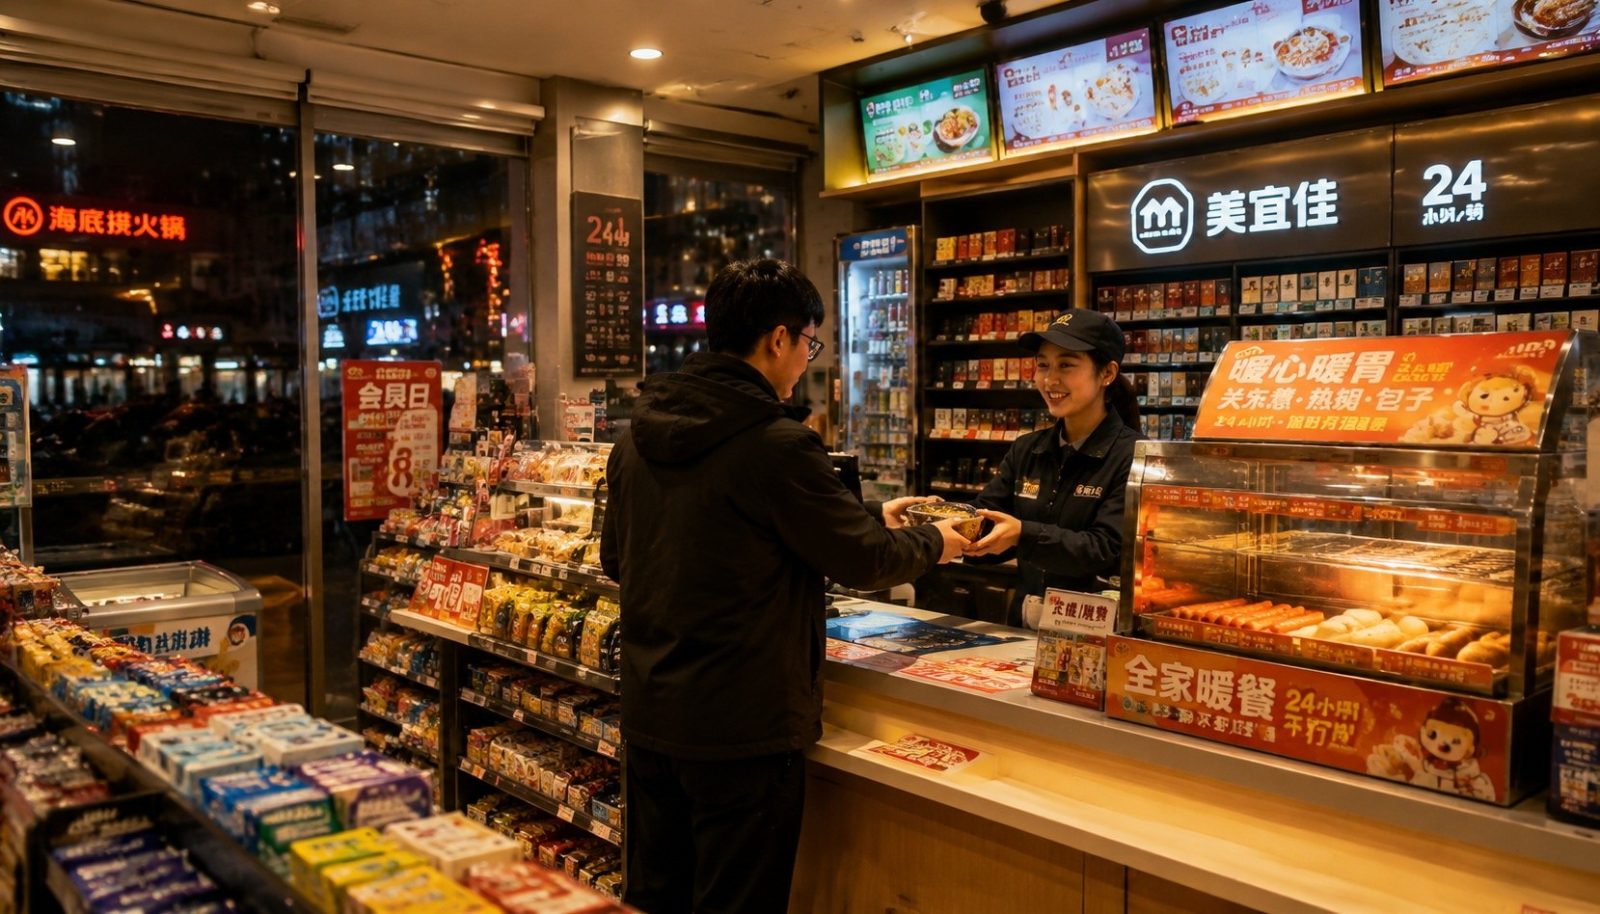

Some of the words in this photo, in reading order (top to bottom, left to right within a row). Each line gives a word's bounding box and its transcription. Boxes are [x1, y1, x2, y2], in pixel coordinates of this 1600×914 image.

[1207, 178, 1339, 237] 美宜佳
[1422, 160, 1487, 206] 24
[1228, 350, 1395, 384] 暖心暖胃
[1124, 654, 1277, 721] 全家暖餐
